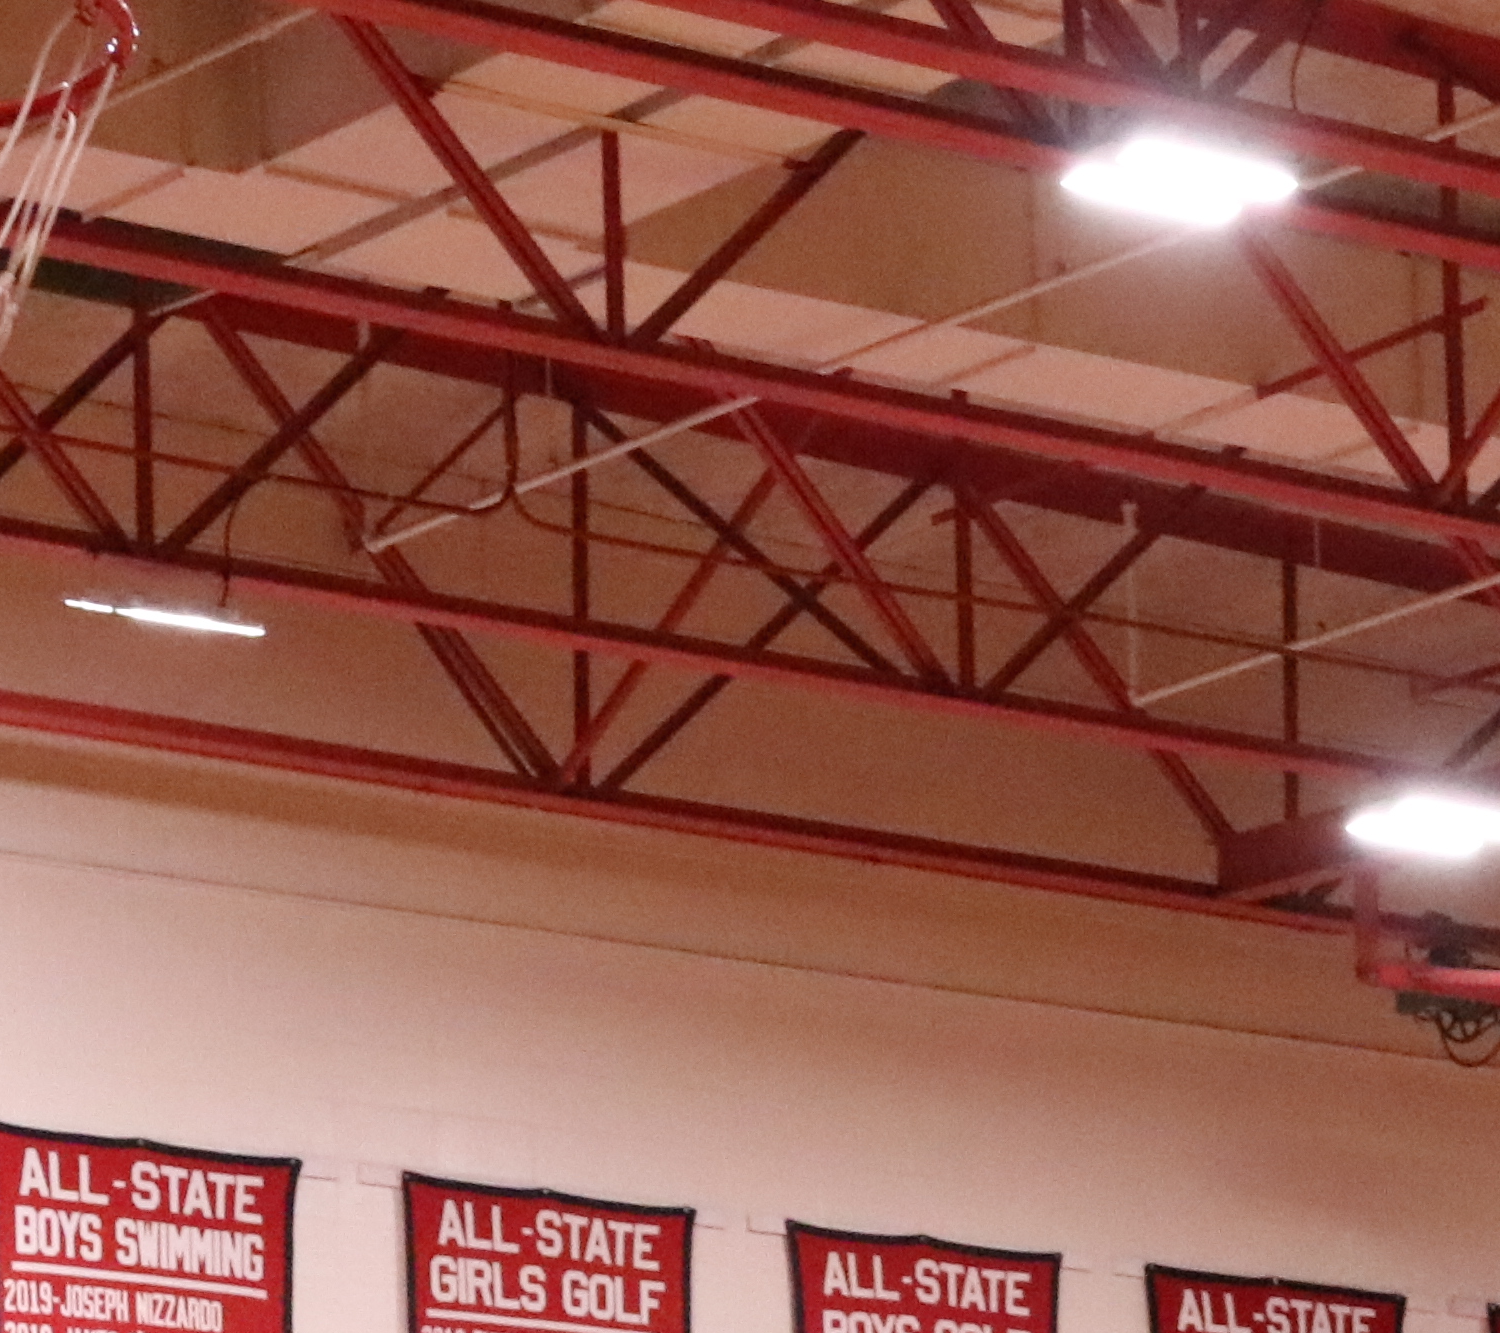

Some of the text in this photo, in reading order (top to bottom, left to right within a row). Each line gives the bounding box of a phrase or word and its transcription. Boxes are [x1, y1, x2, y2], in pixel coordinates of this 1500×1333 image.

[19, 1148, 263, 1224] ALL-STATE
[15, 1205, 263, 1281] BOYS SWIMMING
[438, 1200, 660, 1271] ALL-STATE
[4, 1279, 222, 1332] 2019-JOSEPH NIZZARDO
[430, 1256, 665, 1325] GIRLS GOLF
[824, 1252, 1030, 1316] ALL-STATE
